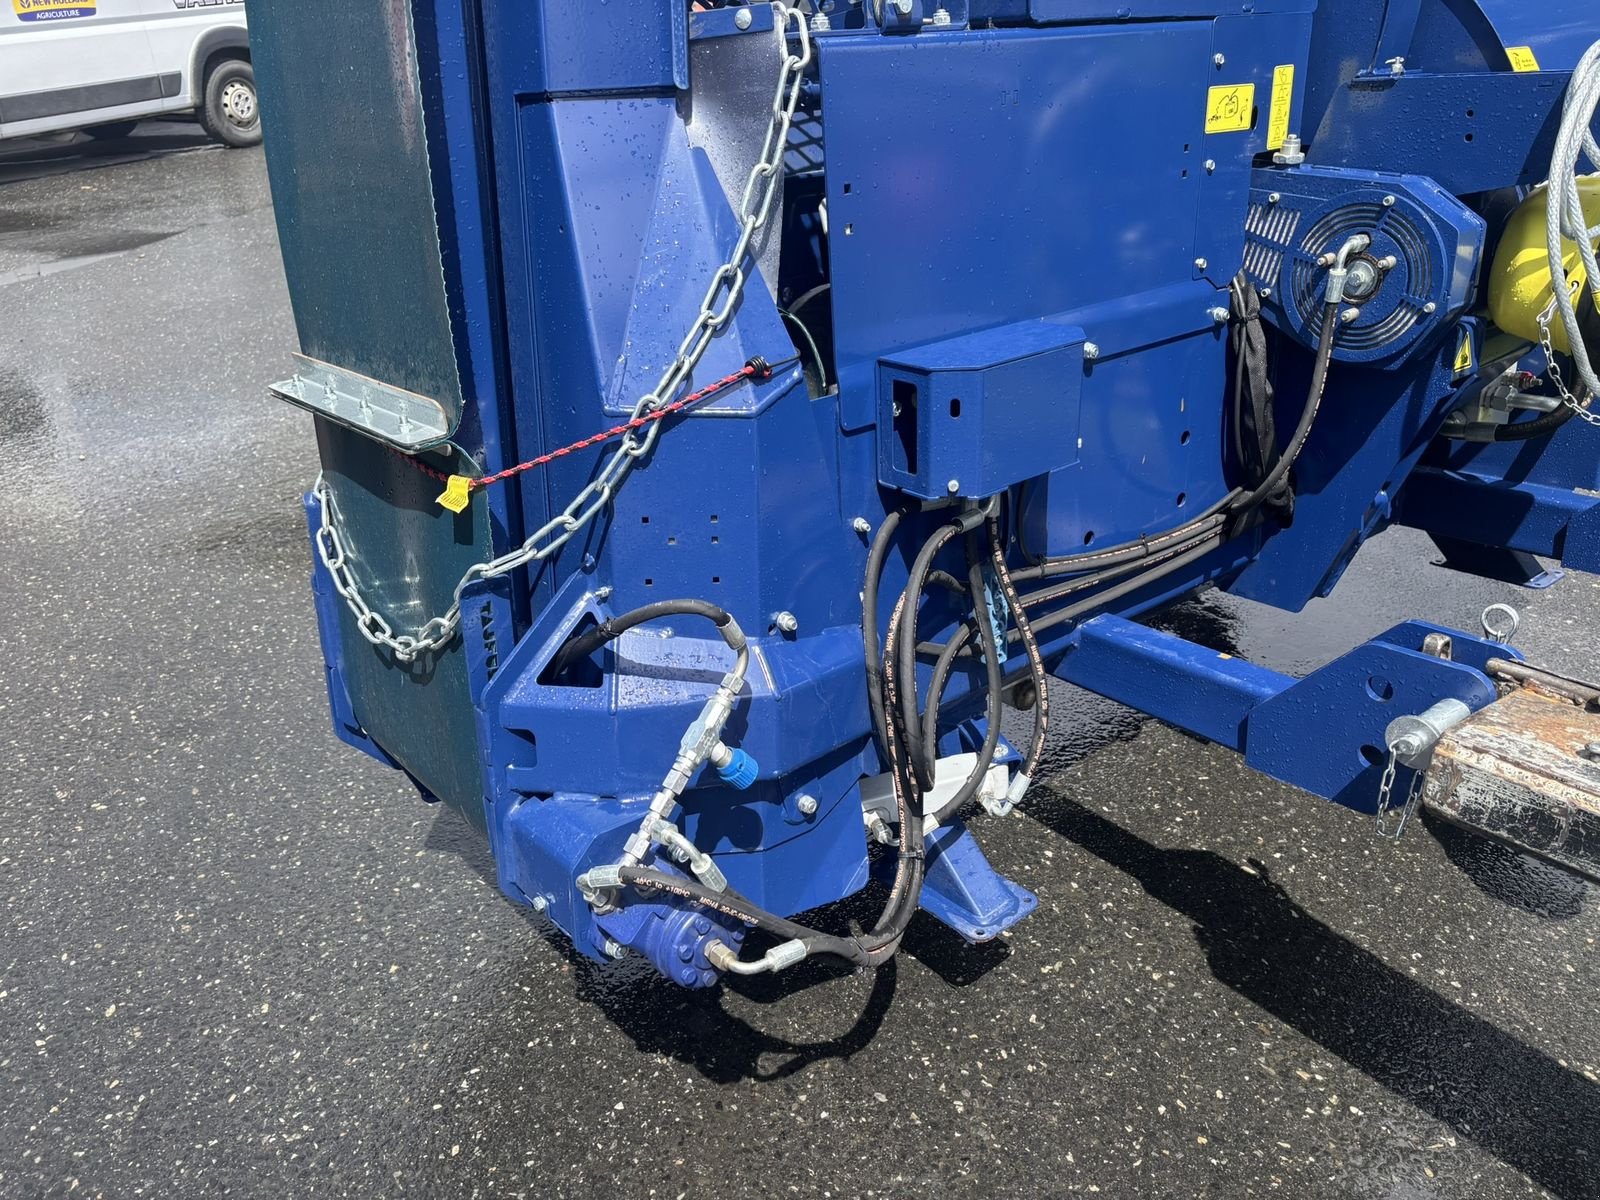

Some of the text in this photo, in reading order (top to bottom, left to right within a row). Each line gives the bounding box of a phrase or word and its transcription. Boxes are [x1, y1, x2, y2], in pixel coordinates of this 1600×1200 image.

[36, 10, 80, 19] AGRICULTURE
[665, 886, 691, 898] +100°C
[700, 896, 719, 910] MSHA
